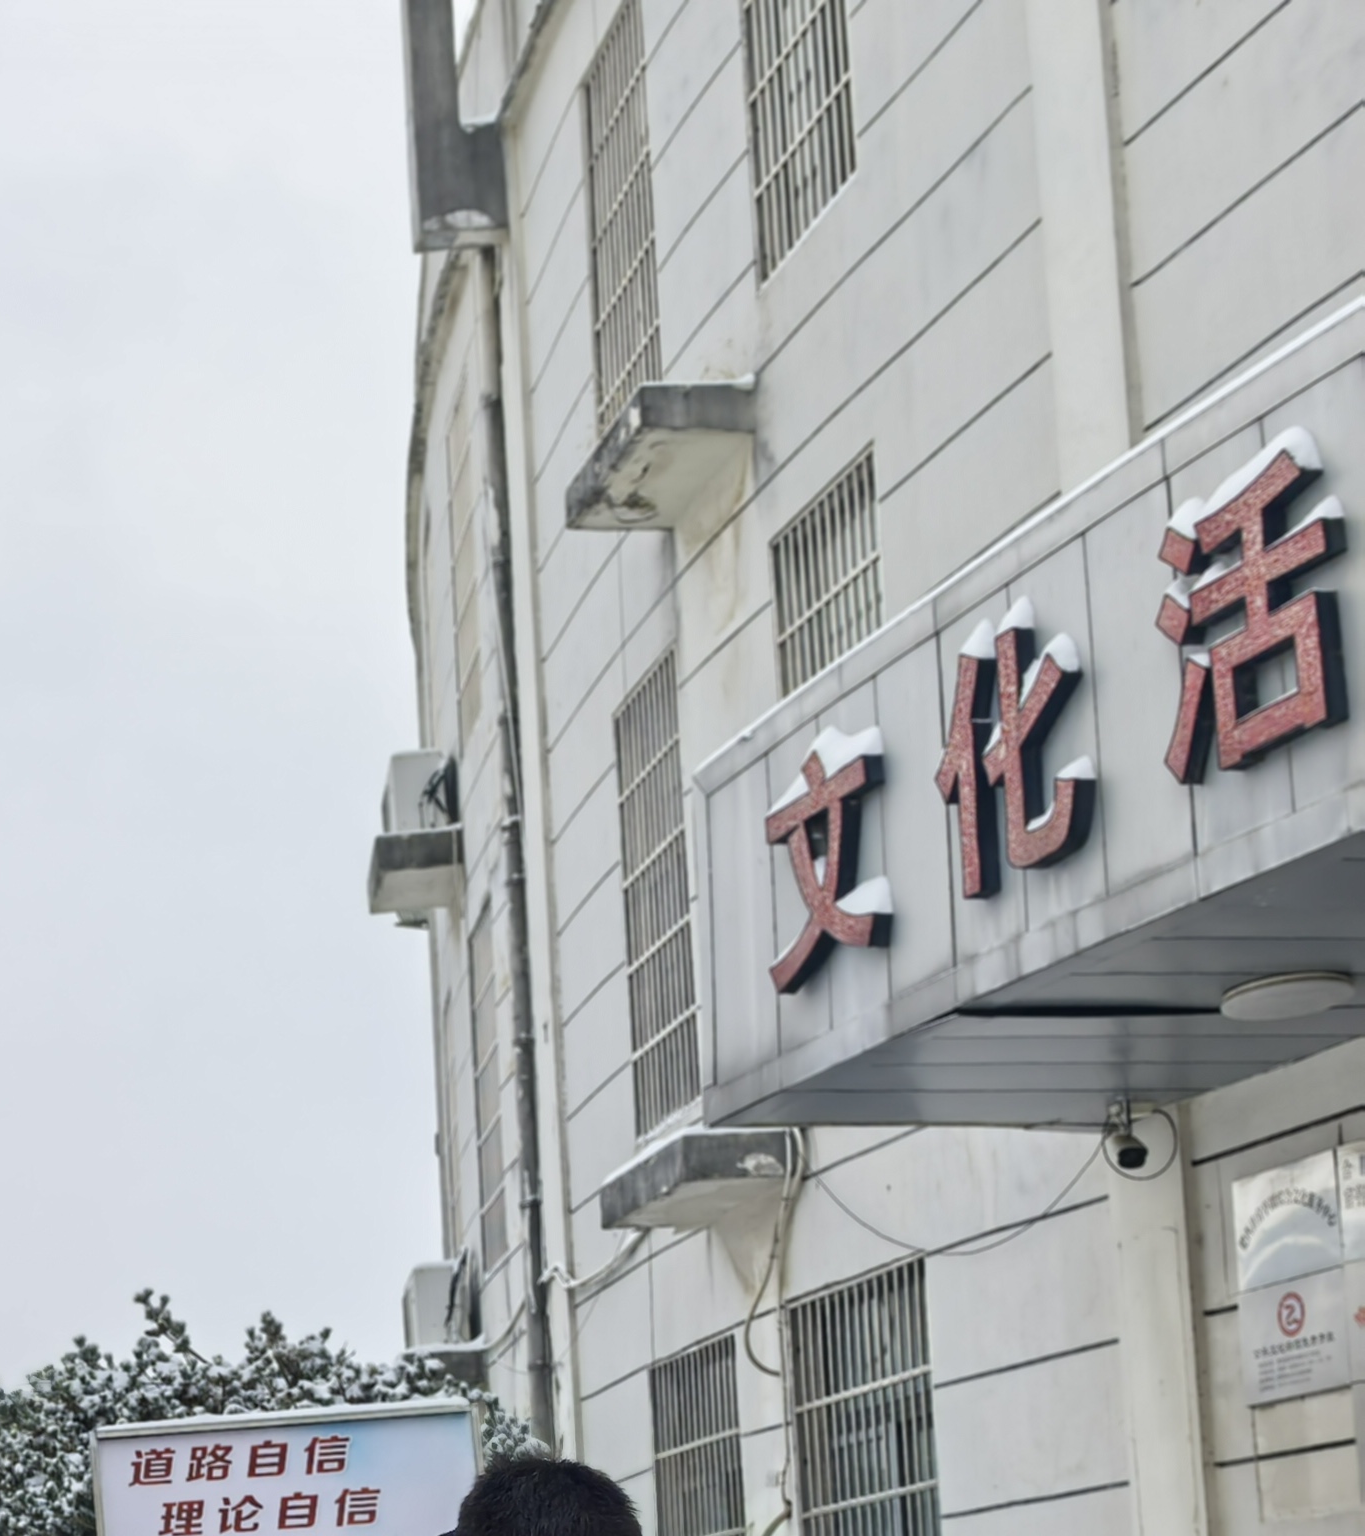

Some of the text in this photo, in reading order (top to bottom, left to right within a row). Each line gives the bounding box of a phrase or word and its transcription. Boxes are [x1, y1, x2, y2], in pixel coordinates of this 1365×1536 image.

[765, 445, 1349, 994] 文化活
[128, 1435, 352, 1487] 道路自信
